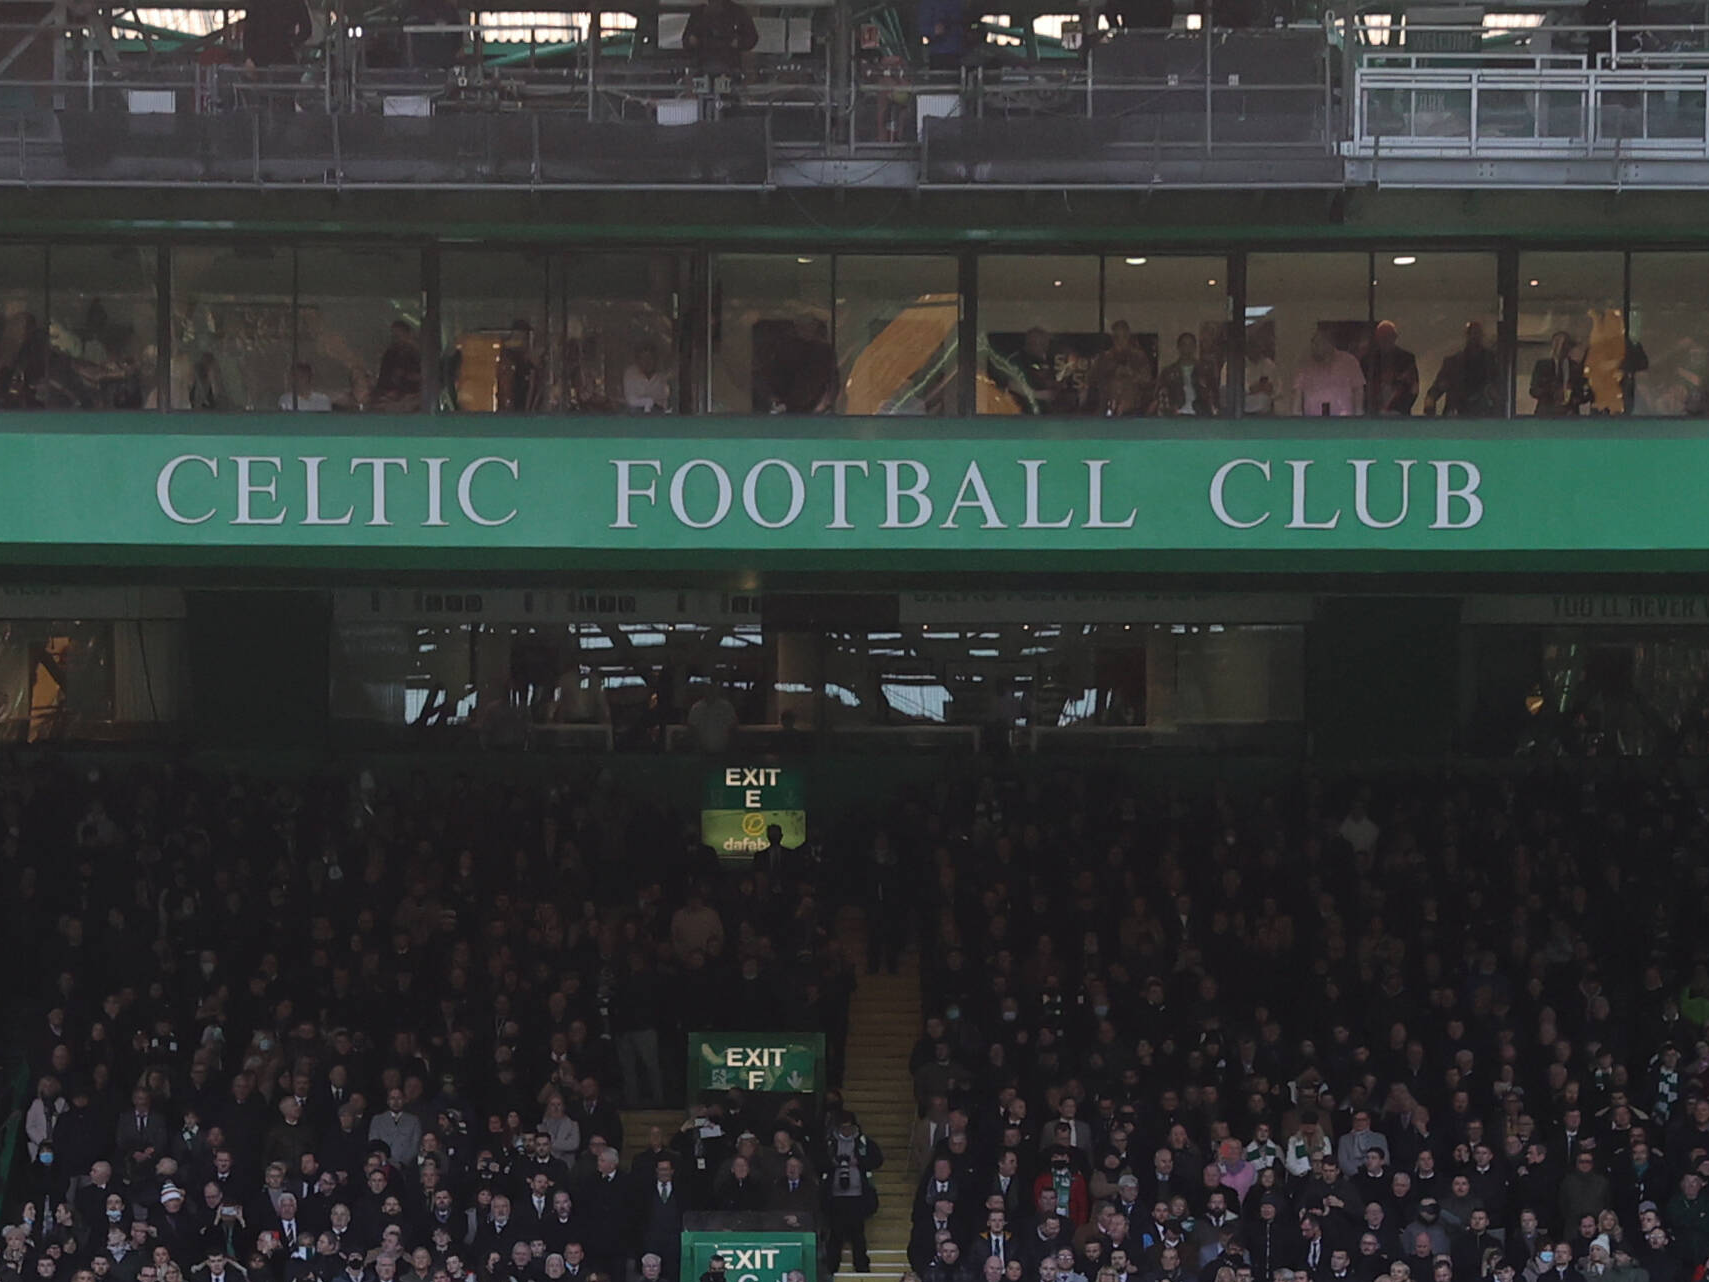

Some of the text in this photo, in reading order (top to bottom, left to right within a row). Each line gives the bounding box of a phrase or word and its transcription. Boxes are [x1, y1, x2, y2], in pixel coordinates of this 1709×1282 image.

[157, 456, 1482, 528] CELTIC FOOTBALL CLUB
[725, 767, 781, 787] EXIT
[745, 790, 762, 808] E
[723, 837, 771, 851] dafab
[726, 1047, 787, 1067] EXIT
[748, 1070, 765, 1090] F
